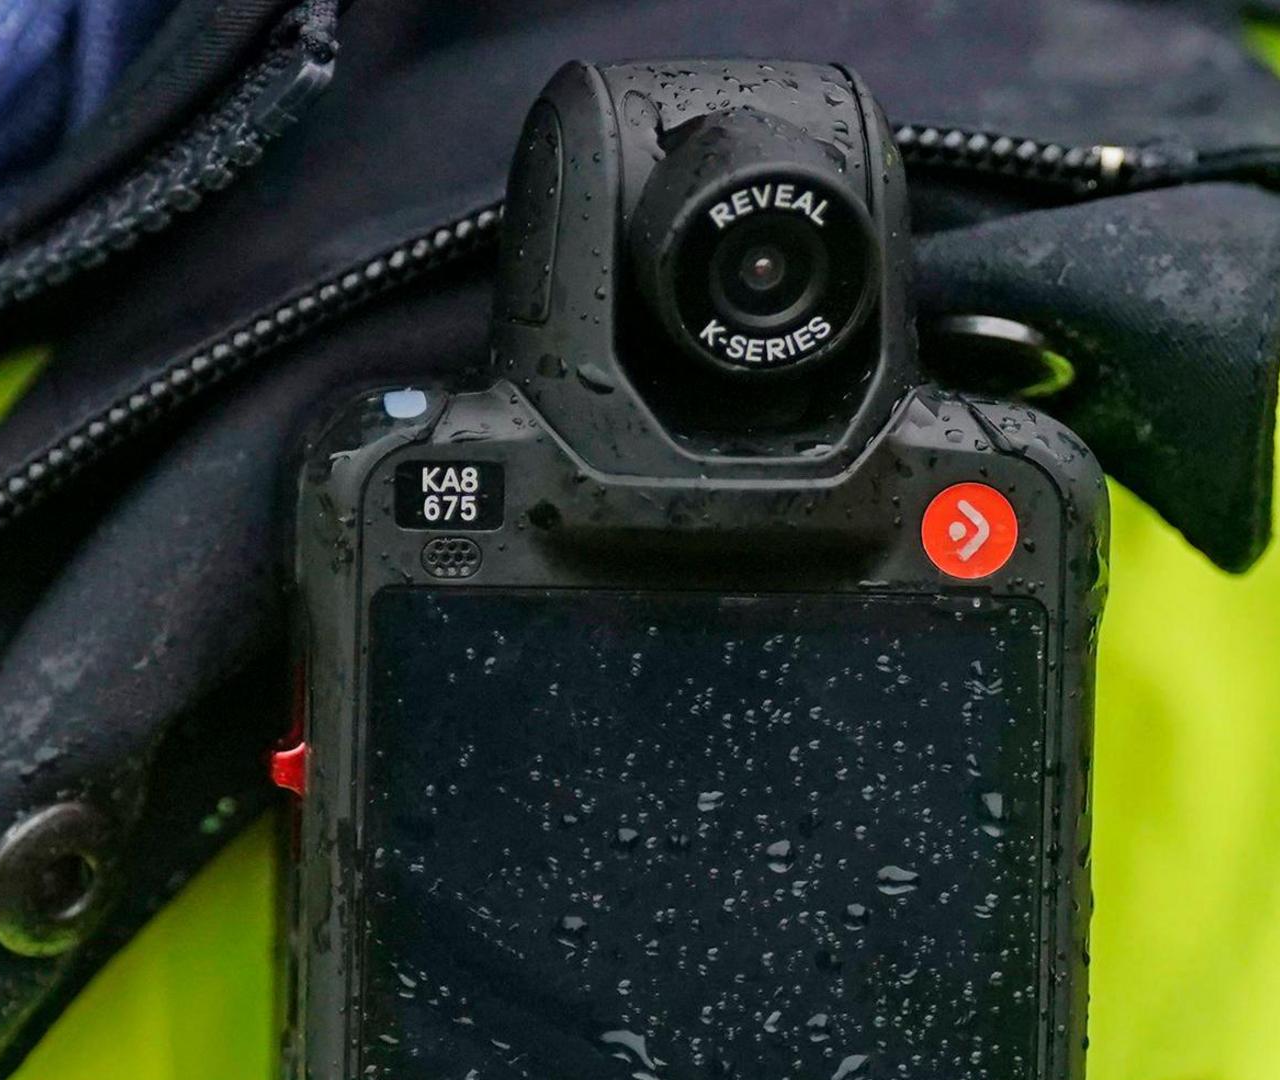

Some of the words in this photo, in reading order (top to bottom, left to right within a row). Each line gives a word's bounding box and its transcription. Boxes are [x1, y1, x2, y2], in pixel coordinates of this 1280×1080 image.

[709, 184, 828, 229] REVEAL
[699, 316, 831, 362] K-SERIES
[422, 466, 479, 493] KA8
[424, 495, 477, 521] 675
